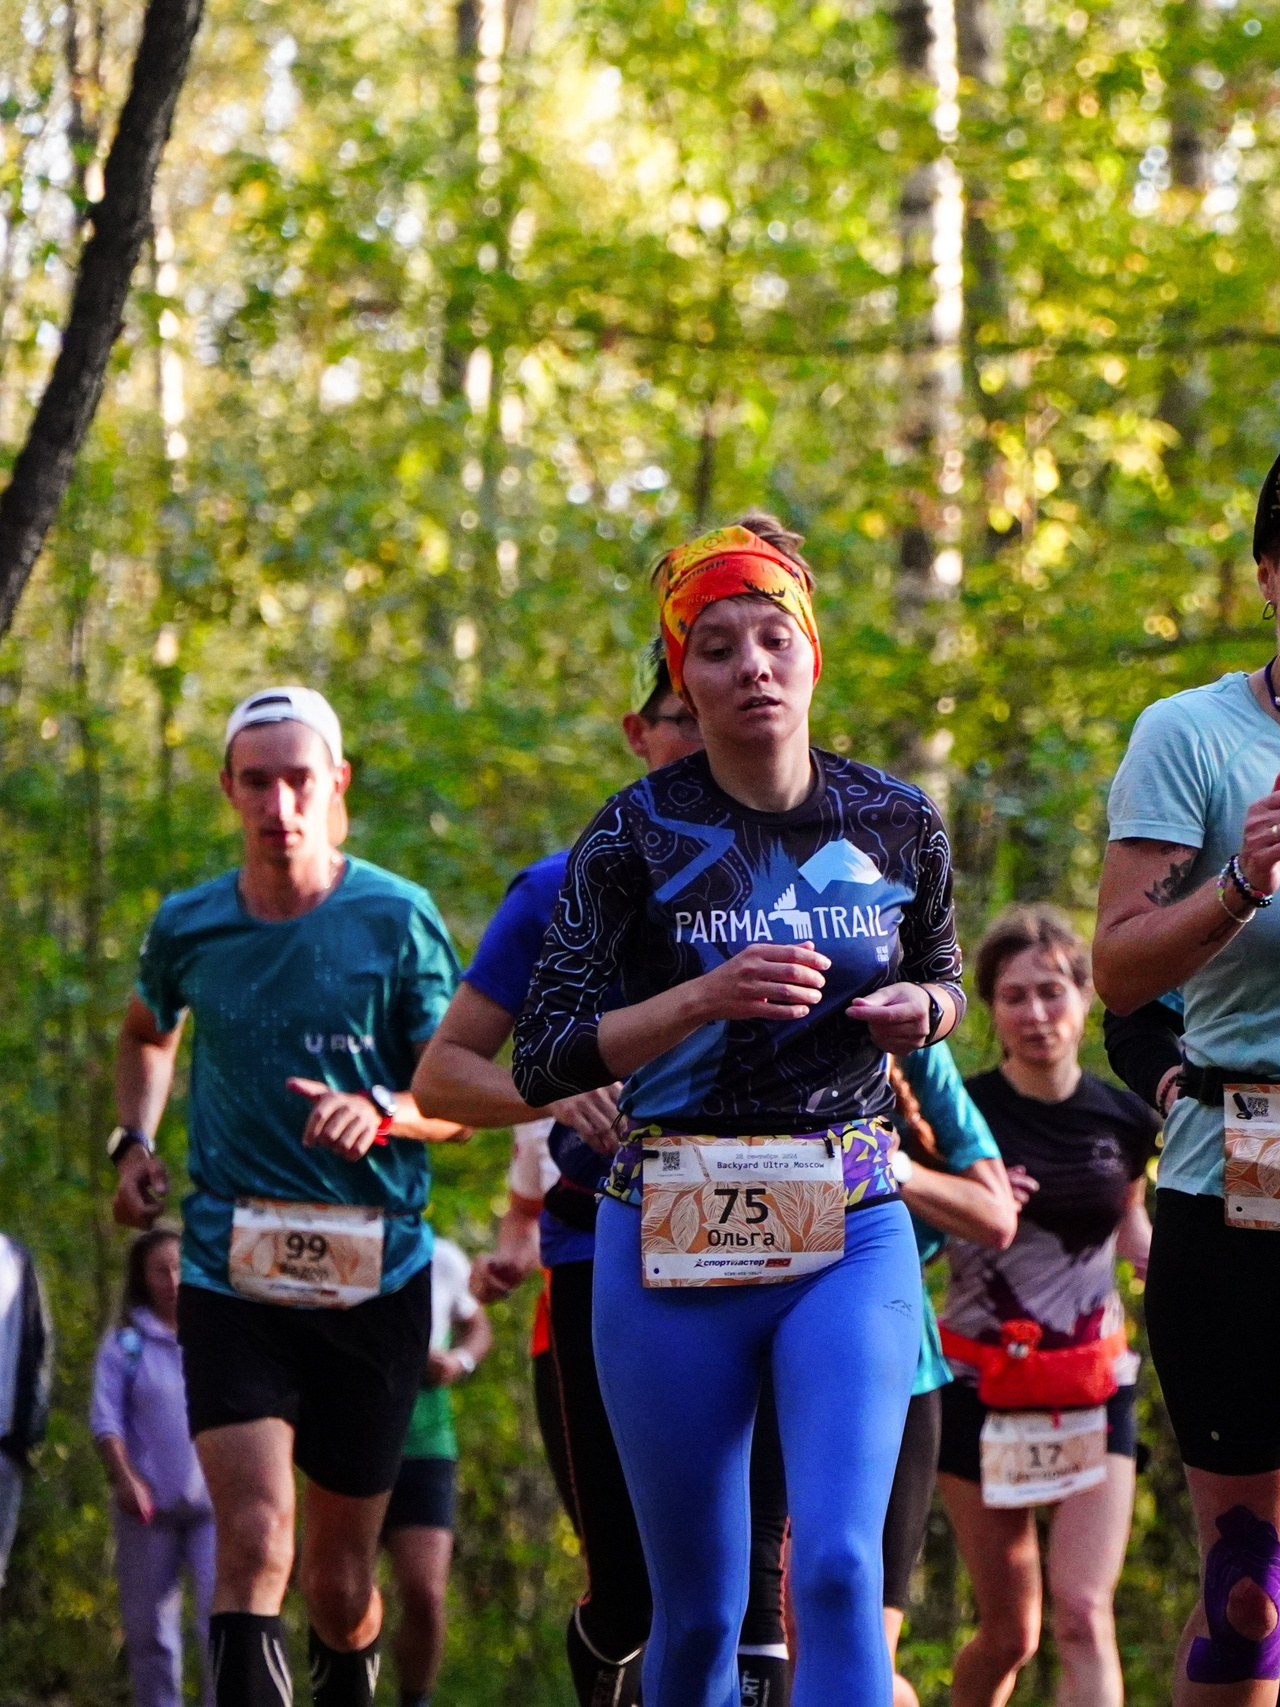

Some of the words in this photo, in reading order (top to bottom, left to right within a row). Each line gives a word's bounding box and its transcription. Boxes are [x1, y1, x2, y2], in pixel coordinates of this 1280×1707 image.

[676, 909, 772, 943] PARMA
[814, 905, 888, 939] TRAIL
[716, 1161, 758, 1170] Backyard
[763, 1161, 788, 1169] Ultra
[794, 1161, 825, 1169] Moscow
[714, 1188, 768, 1224] 75
[287, 1233, 327, 1262] 99
[708, 1230, 775, 1246] Ольга
[766, 1258, 791, 1268] PRO
[1029, 1444, 1062, 1467] 17
